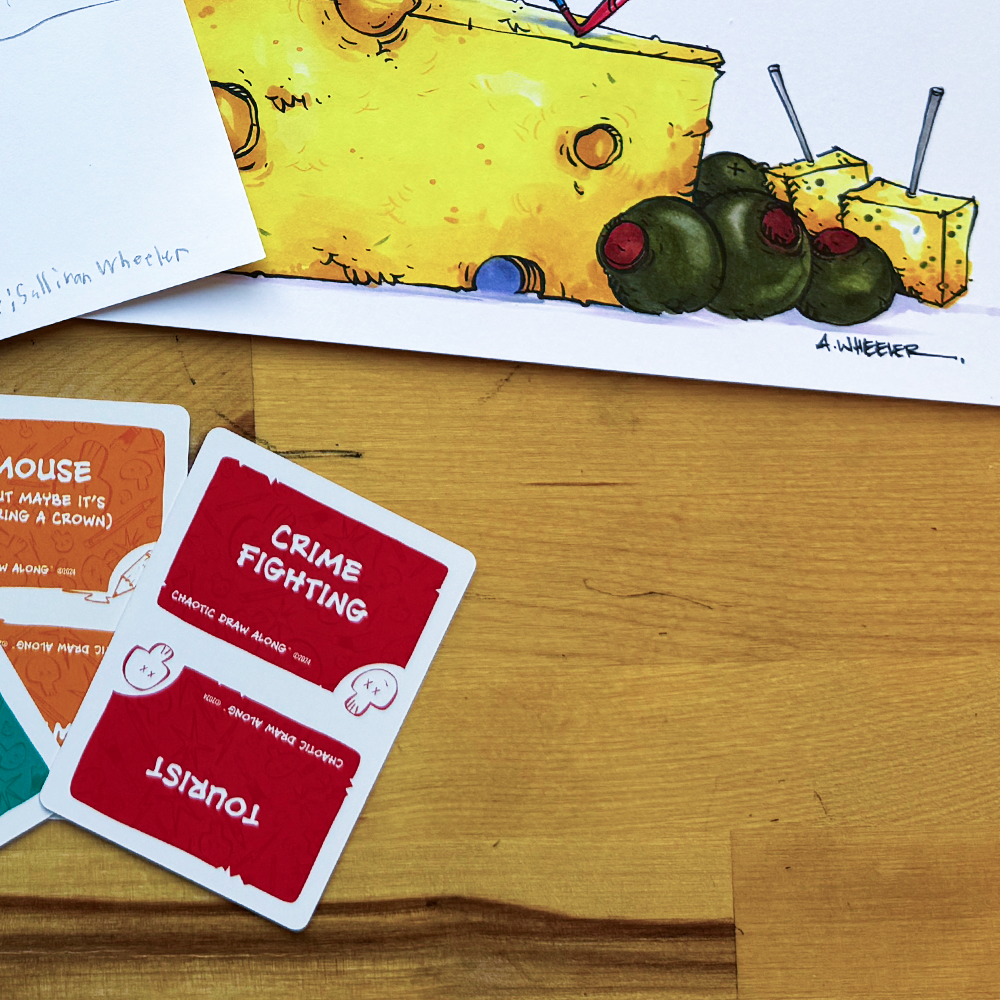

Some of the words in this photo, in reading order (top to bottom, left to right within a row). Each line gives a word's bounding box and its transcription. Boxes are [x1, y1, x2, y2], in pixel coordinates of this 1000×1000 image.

[18, 491, 72, 508] MAYBE
[78, 494, 106, 509] IT'S
[36, 511, 46, 525] A
[52, 512, 113, 530] CROWN)
[271, 524, 364, 583] CRIME
[237, 543, 369, 624] FIGHTING
[171, 590, 216, 619] CHAOTIC
[218, 613, 250, 636] DRAW
[57, 643, 89, 655] DRAW
[265, 723, 297, 747] DRAW
[298, 740, 344, 769] CHAOTIC
[146, 755, 262, 827] TOURIST
